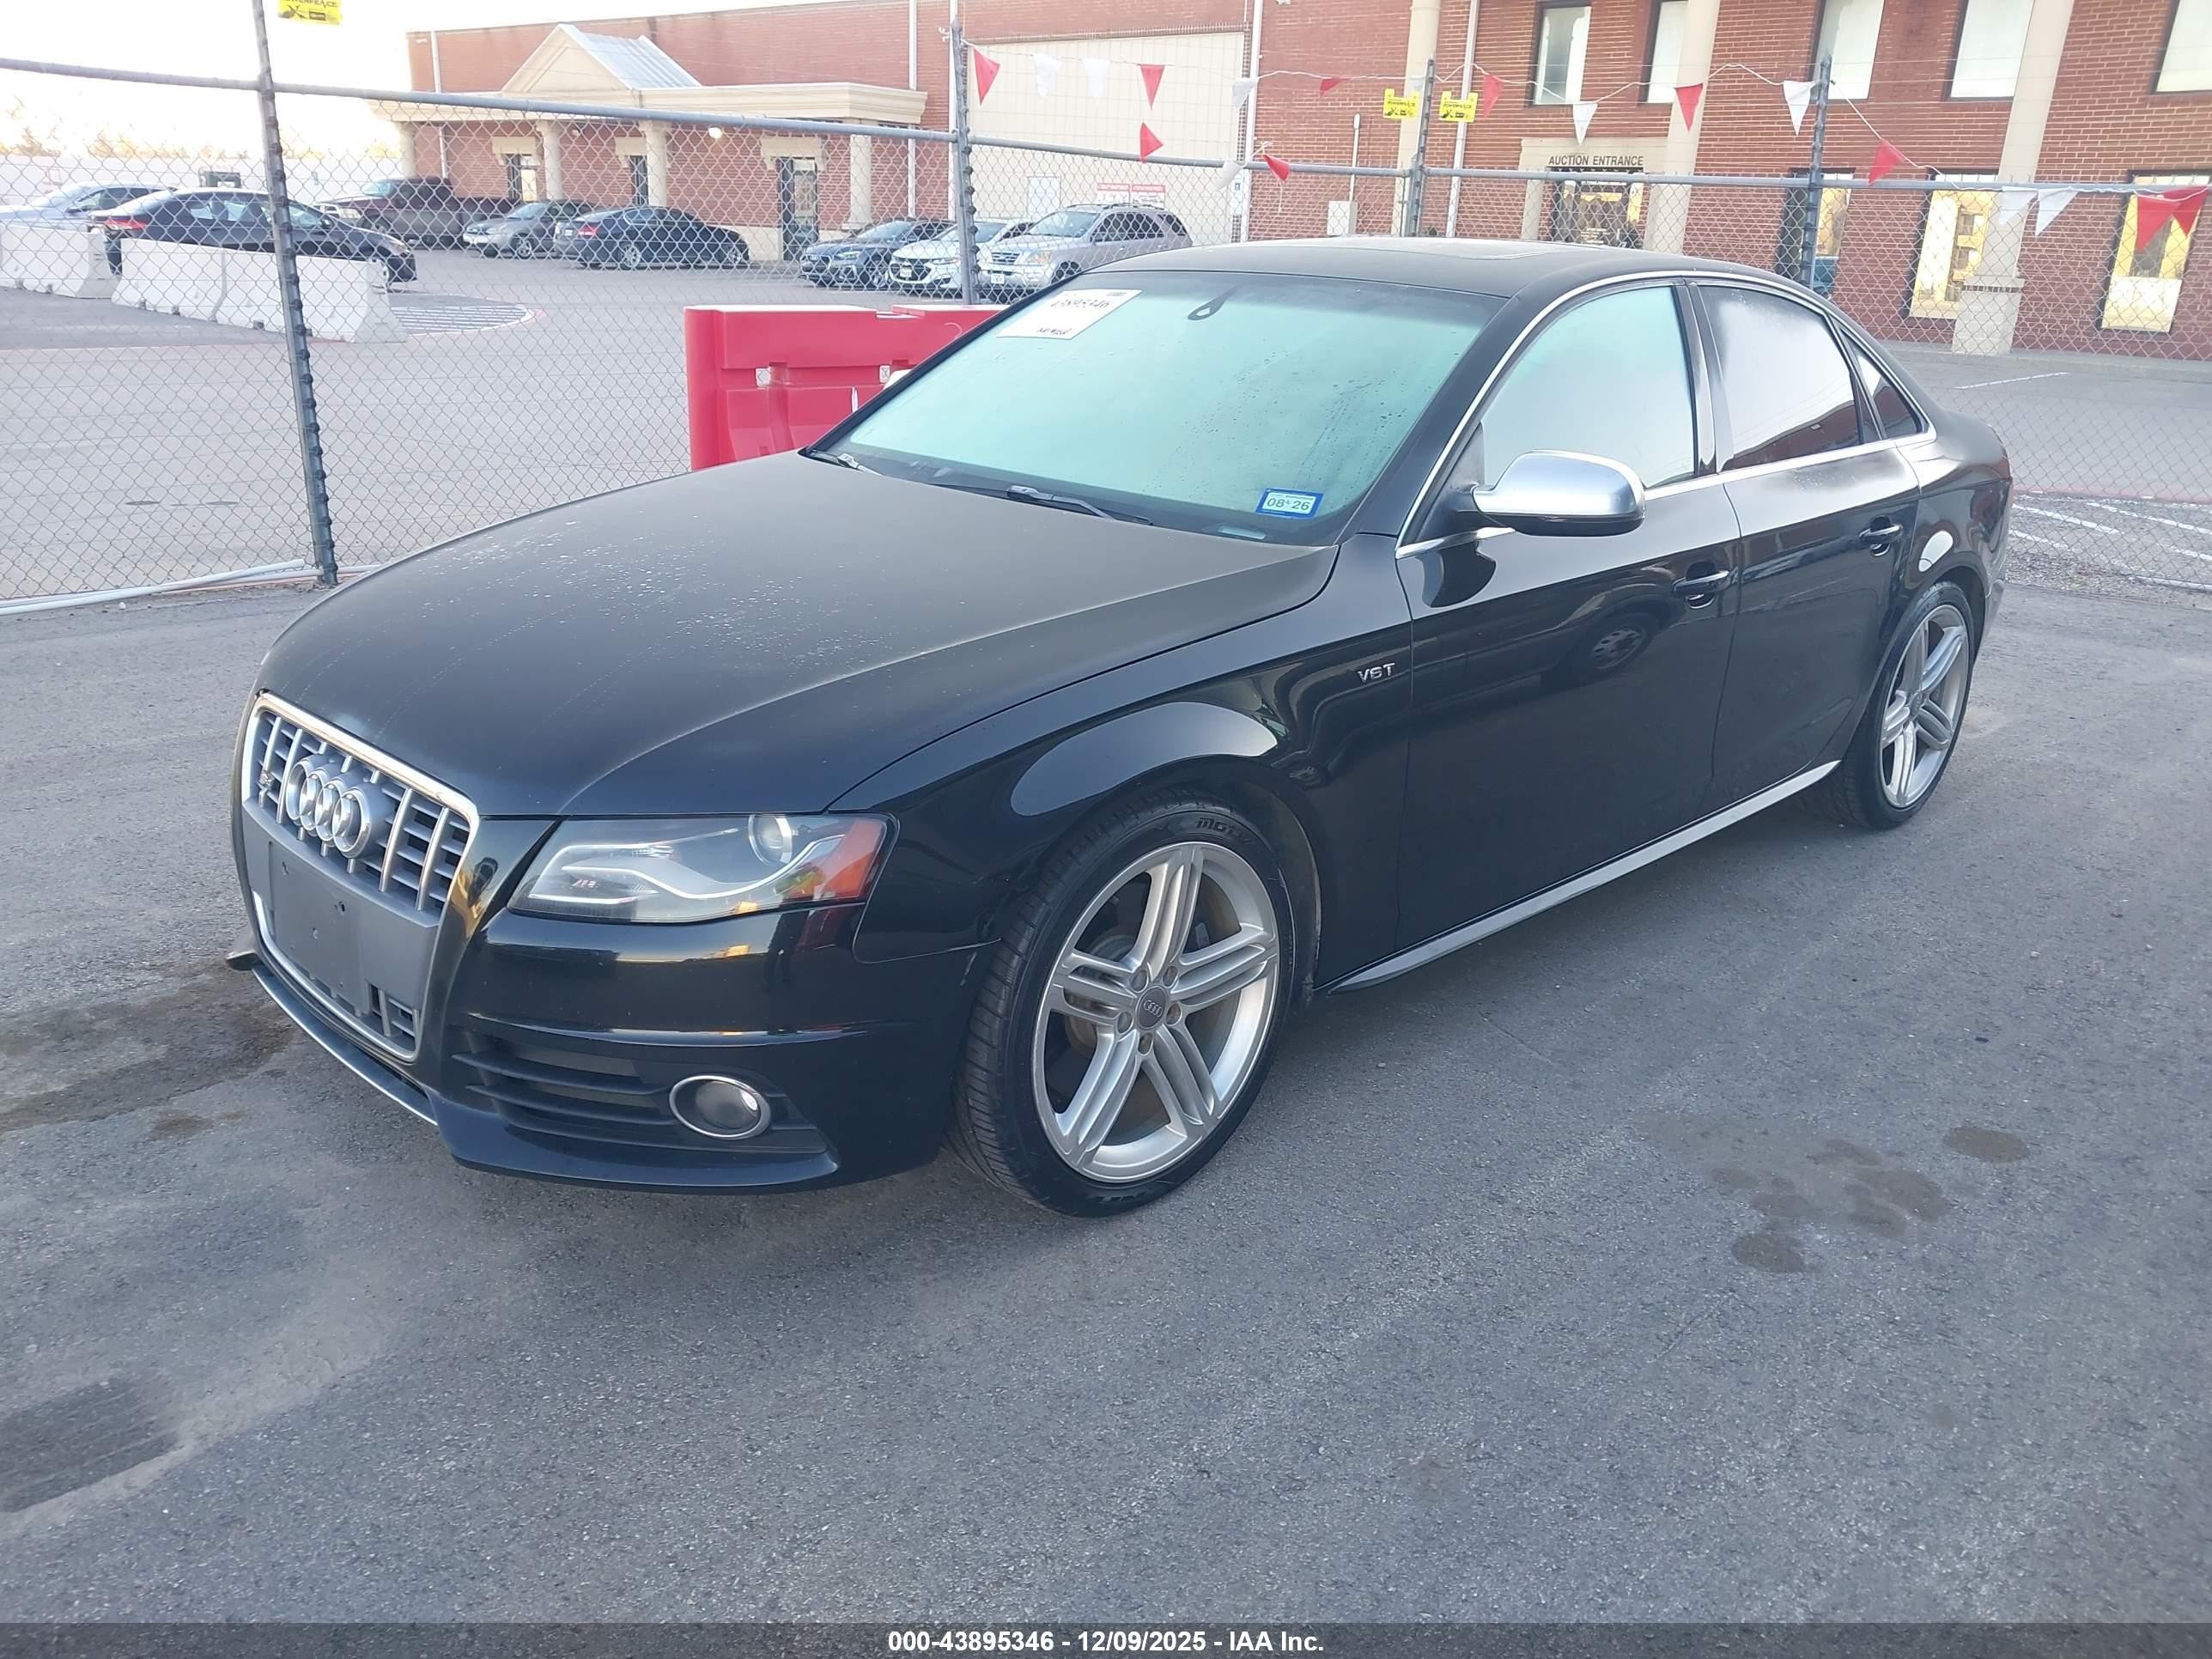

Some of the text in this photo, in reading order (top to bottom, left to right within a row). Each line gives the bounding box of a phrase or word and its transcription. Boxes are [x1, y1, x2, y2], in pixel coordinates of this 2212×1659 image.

[1548, 155, 1644, 167] AUCTION ENTRANCE
[1267, 498, 1310, 510] 08 26
[1358, 663, 1395, 683] V6T
